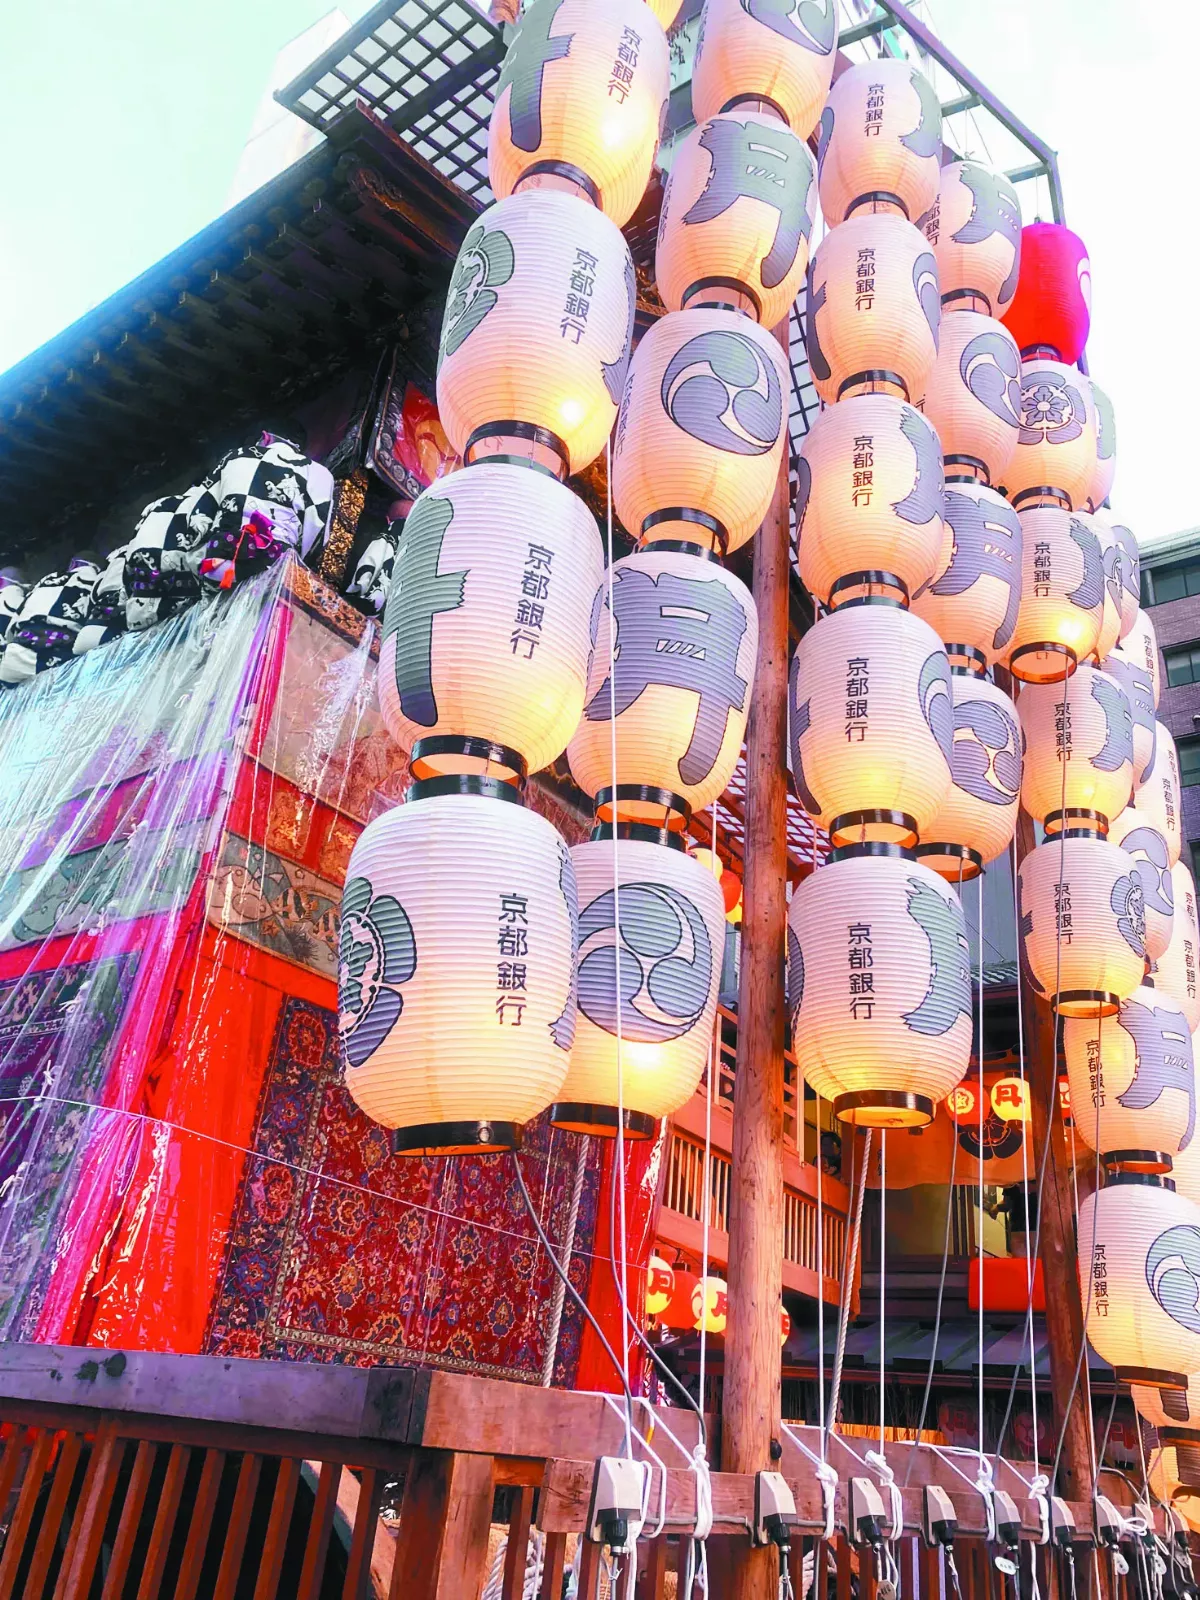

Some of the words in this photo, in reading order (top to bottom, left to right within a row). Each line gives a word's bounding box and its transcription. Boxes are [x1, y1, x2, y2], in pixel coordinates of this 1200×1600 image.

[607, 24, 642, 104] 京都銀行
[864, 83, 885, 137] 京都銀行
[560, 246, 599, 345] 京都銀行
[855, 248, 876, 311] 京都銀行
[852, 435, 875, 507] 京都銀行
[510, 541, 554, 660] 京都銀行
[1033, 542, 1052, 597] 京都銀行
[844, 656, 870, 743] 京都銀行
[1054, 702, 1073, 762] 京都銀行
[1053, 883, 1073, 946] 京都銀行
[495, 892, 529, 1027] 京都銀行
[847, 922, 876, 1021] 京都銀行
[1086, 1040, 1107, 1108] 京都銀行
[1093, 1243, 1109, 1318] 京都銀行
